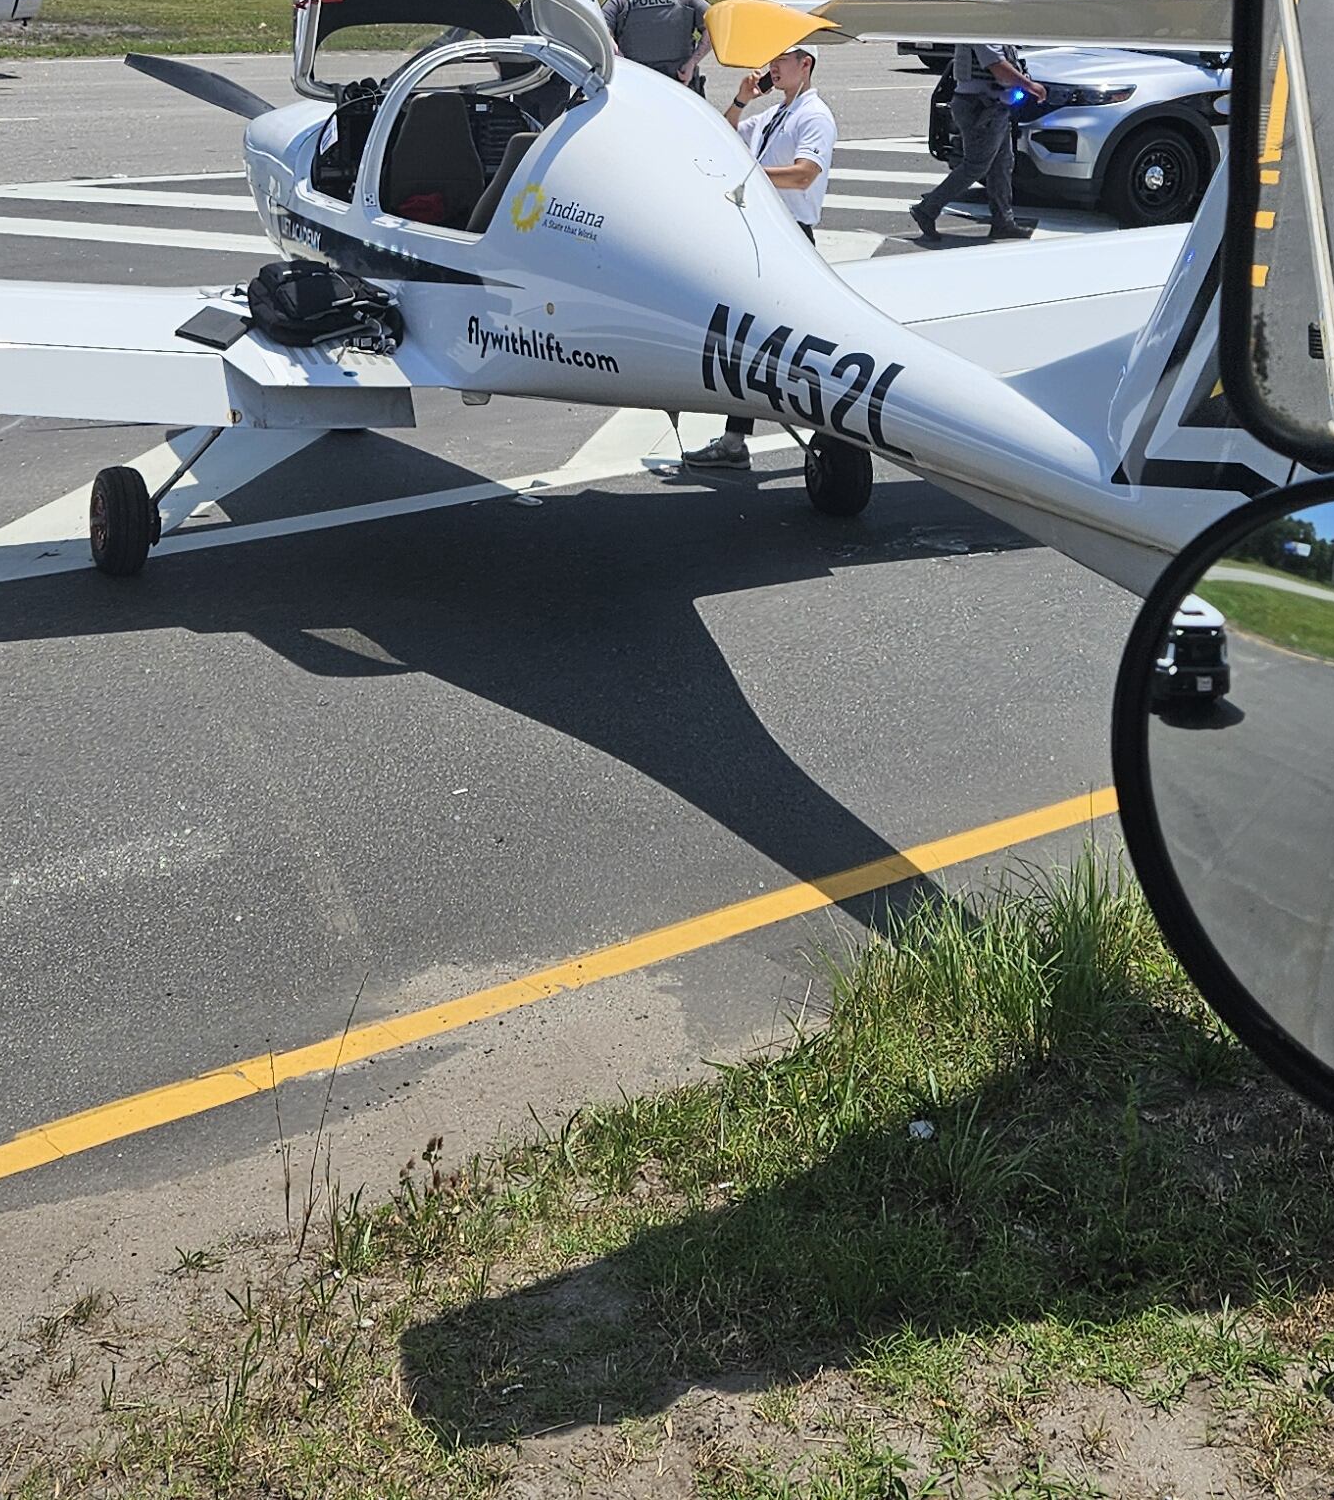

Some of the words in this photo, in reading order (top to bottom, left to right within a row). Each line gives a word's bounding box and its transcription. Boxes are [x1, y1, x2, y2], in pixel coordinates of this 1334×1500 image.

[546, 196, 605, 228] Indiana
[292, 222, 322, 252] ACADEMY
[548, 220, 564, 232] State
[563, 224, 577, 236] that
[578, 228, 598, 240] Works
[467, 315, 620, 374] flywithlift.com
[702, 302, 916, 459] N452L
